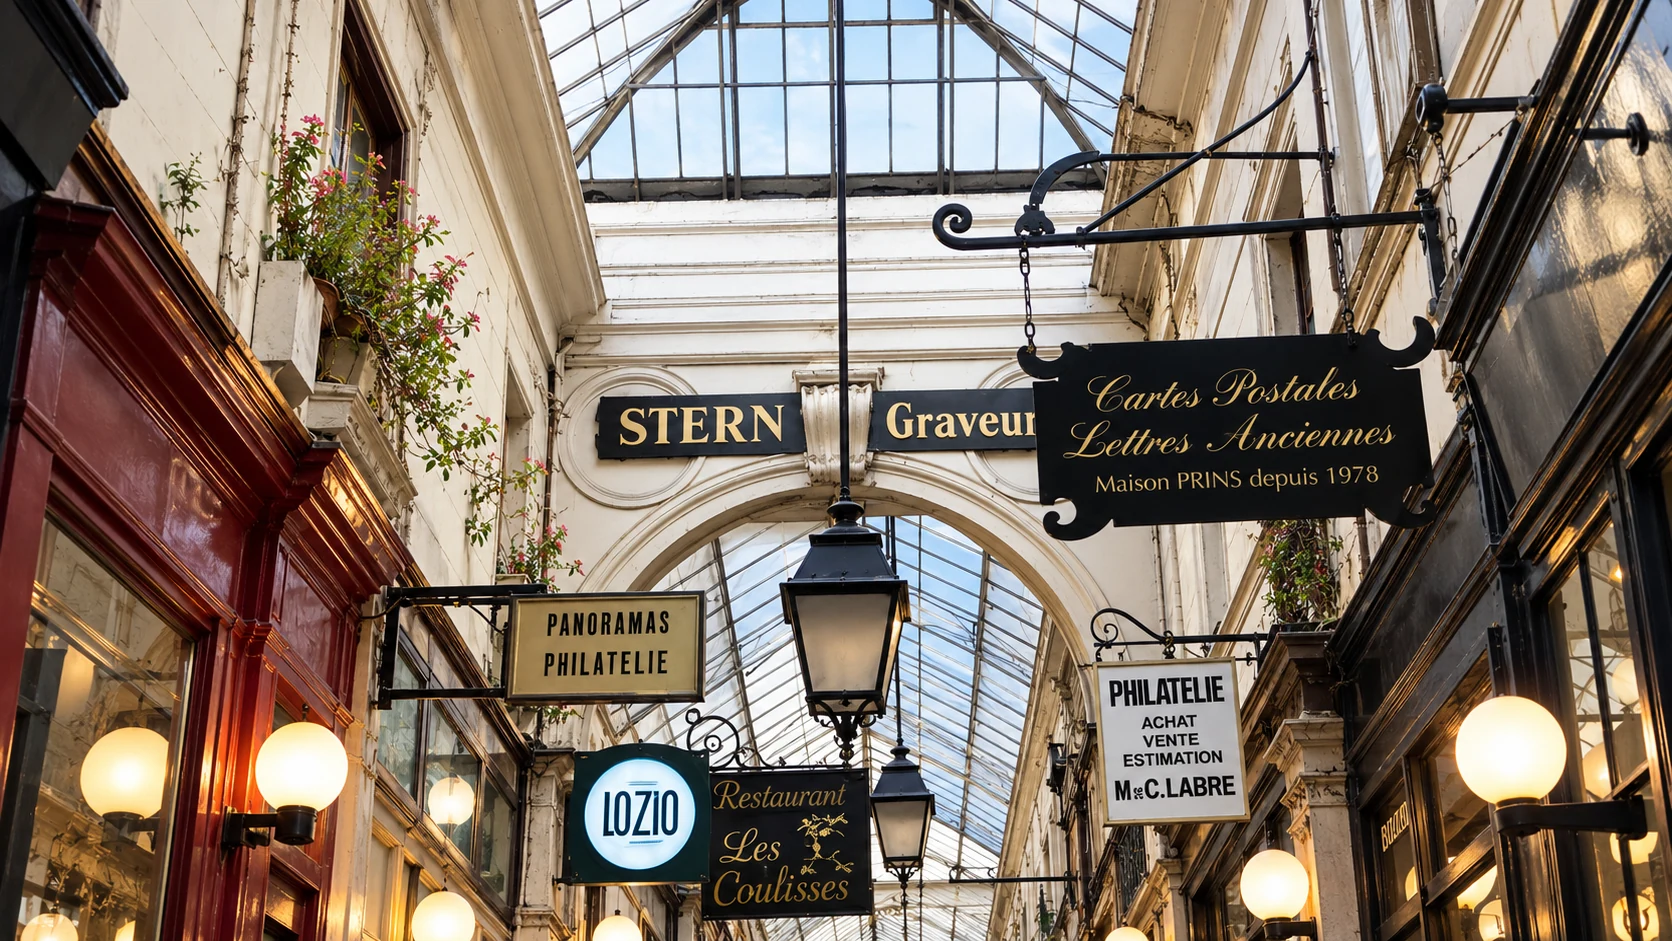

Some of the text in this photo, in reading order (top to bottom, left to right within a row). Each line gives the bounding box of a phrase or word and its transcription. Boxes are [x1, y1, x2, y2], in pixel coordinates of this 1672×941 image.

[1087, 366, 1360, 412] Cartes Postales
[619, 402, 1035, 446] STERN Graveur
[1062, 413, 1396, 459] Lettres Anciennes
[1095, 465, 1379, 493] Maison PRINS depuis 1978
[547, 611, 670, 636] PANORAMAS
[544, 650, 668, 677] PHILATELIE
[1109, 675, 1225, 707] PHILATELIE
[1141, 714, 1198, 730] ACHAT
[1142, 732, 1200, 748] VENTE
[1122, 750, 1223, 768] ESTIMATION
[713, 780, 846, 810] Restaurant
[602, 789, 679, 837] LOZIO
[719, 827, 781, 863] Les
[713, 865, 849, 907] Coulisses
